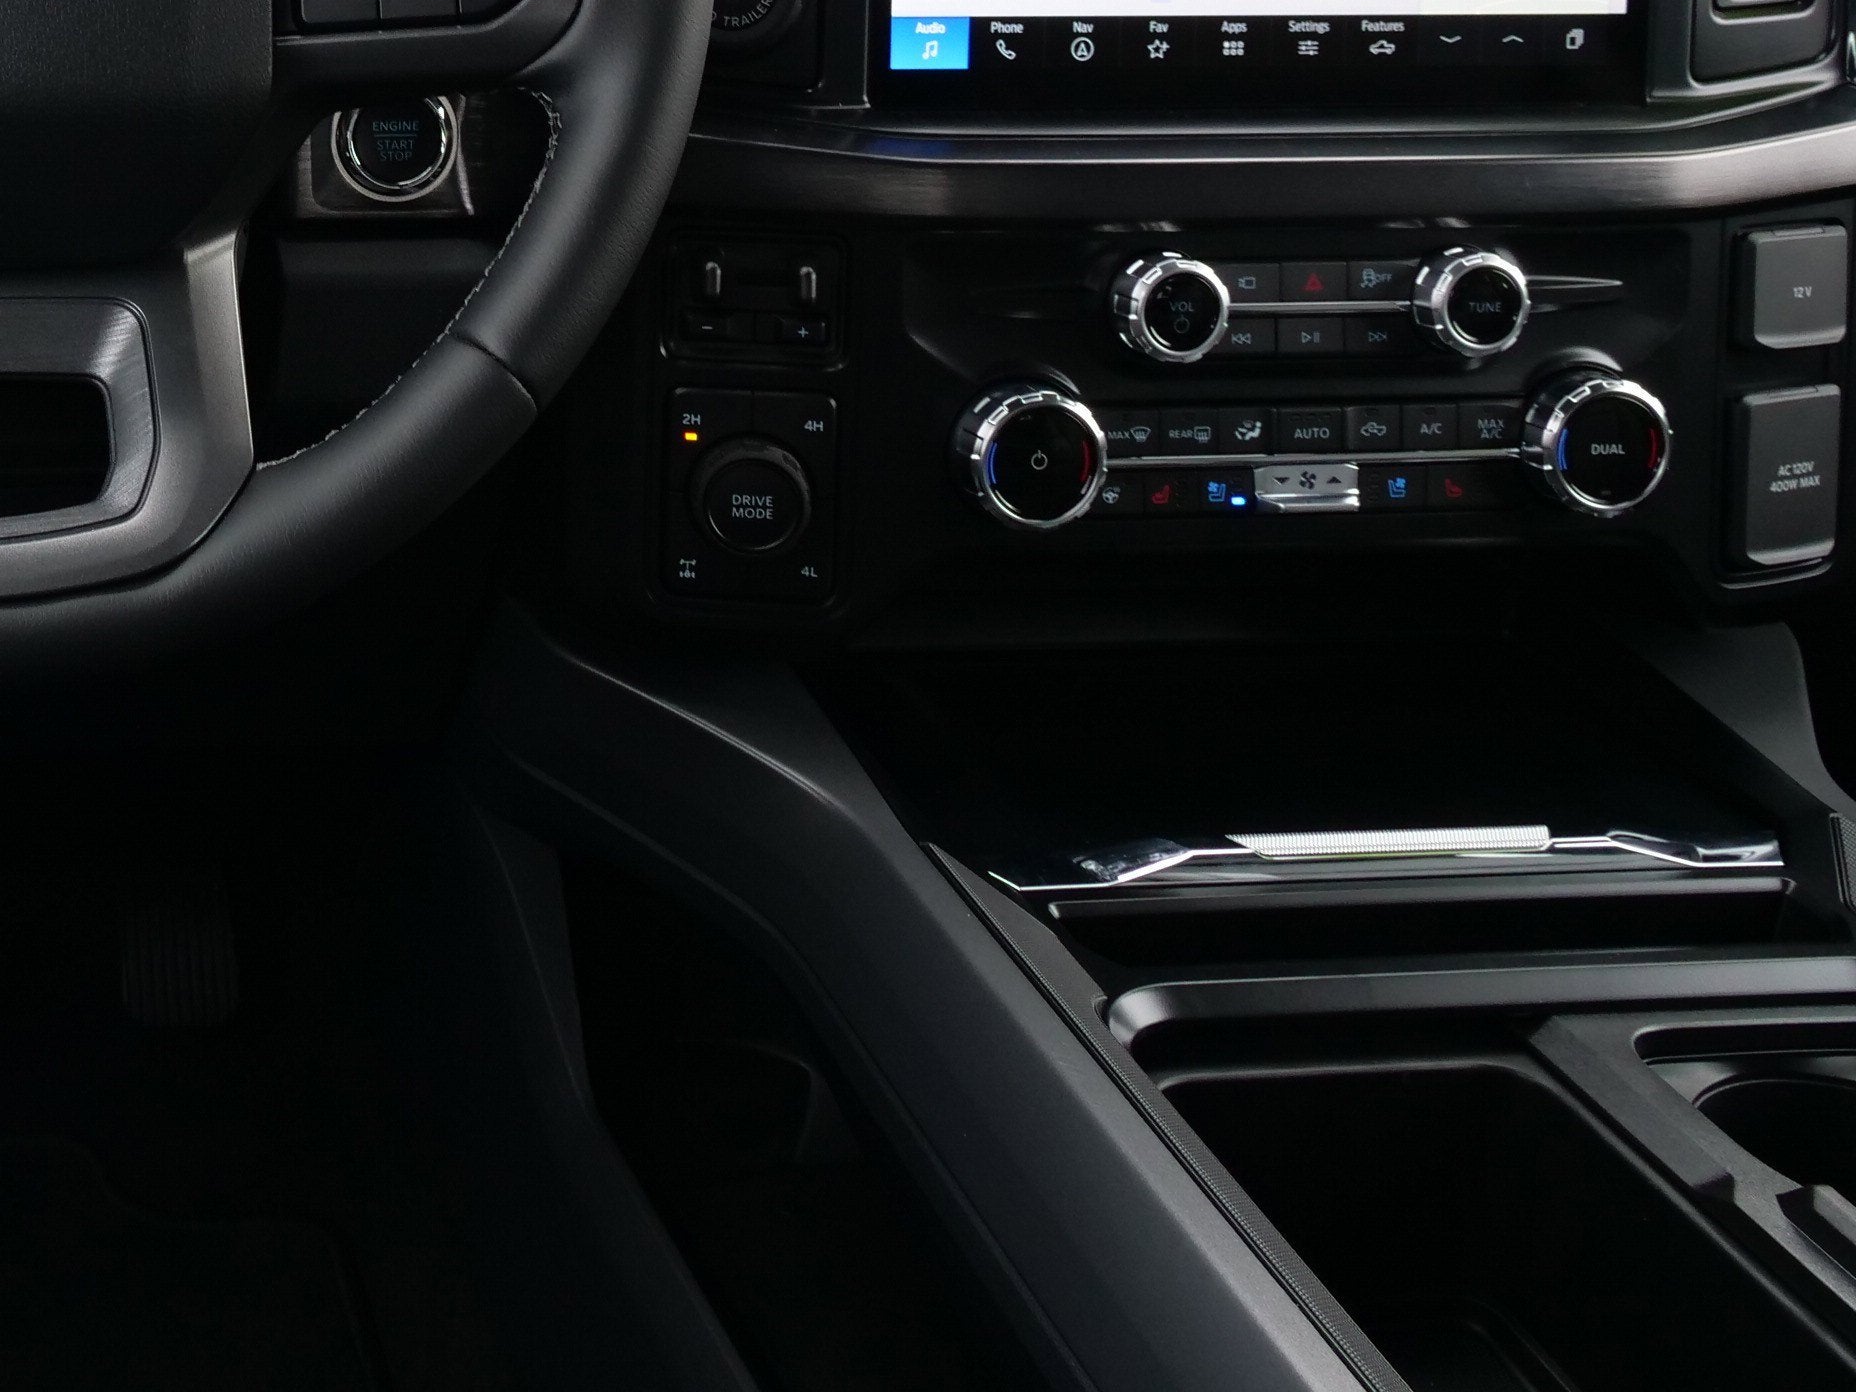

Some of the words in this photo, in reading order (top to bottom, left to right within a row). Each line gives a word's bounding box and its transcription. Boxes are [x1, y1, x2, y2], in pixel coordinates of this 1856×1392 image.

[915, 21, 947, 34] Audio
[990, 21, 1024, 34] Phone
[1072, 21, 1095, 34] Nav
[1149, 21, 1169, 34] Fav
[1221, 21, 1248, 36] Apps
[1288, 20, 1331, 35] Settings
[1361, 20, 1405, 33] Features
[372, 121, 420, 132] ENGINE
[376, 140, 415, 151] START
[379, 151, 413, 162] STOP
[1169, 301, 1195, 312] VOL
[1469, 301, 1502, 312] TUNE
[681, 413, 702, 426] 2H
[1477, 419, 1505, 429] MAX
[803, 420, 825, 433] 4H
[1420, 423, 1442, 436] A/C
[1107, 431, 1131, 440] MAX
[1168, 429, 1193, 439] REAR
[1294, 427, 1330, 440] AUTO
[1480, 429, 1502, 439] A/C
[1590, 444, 1626, 456] DUAL
[1799, 475, 1820, 488] MAX
[731, 494, 774, 508] DRIVE
[731, 507, 774, 520] MODE
[800, 566, 818, 578] 4L
